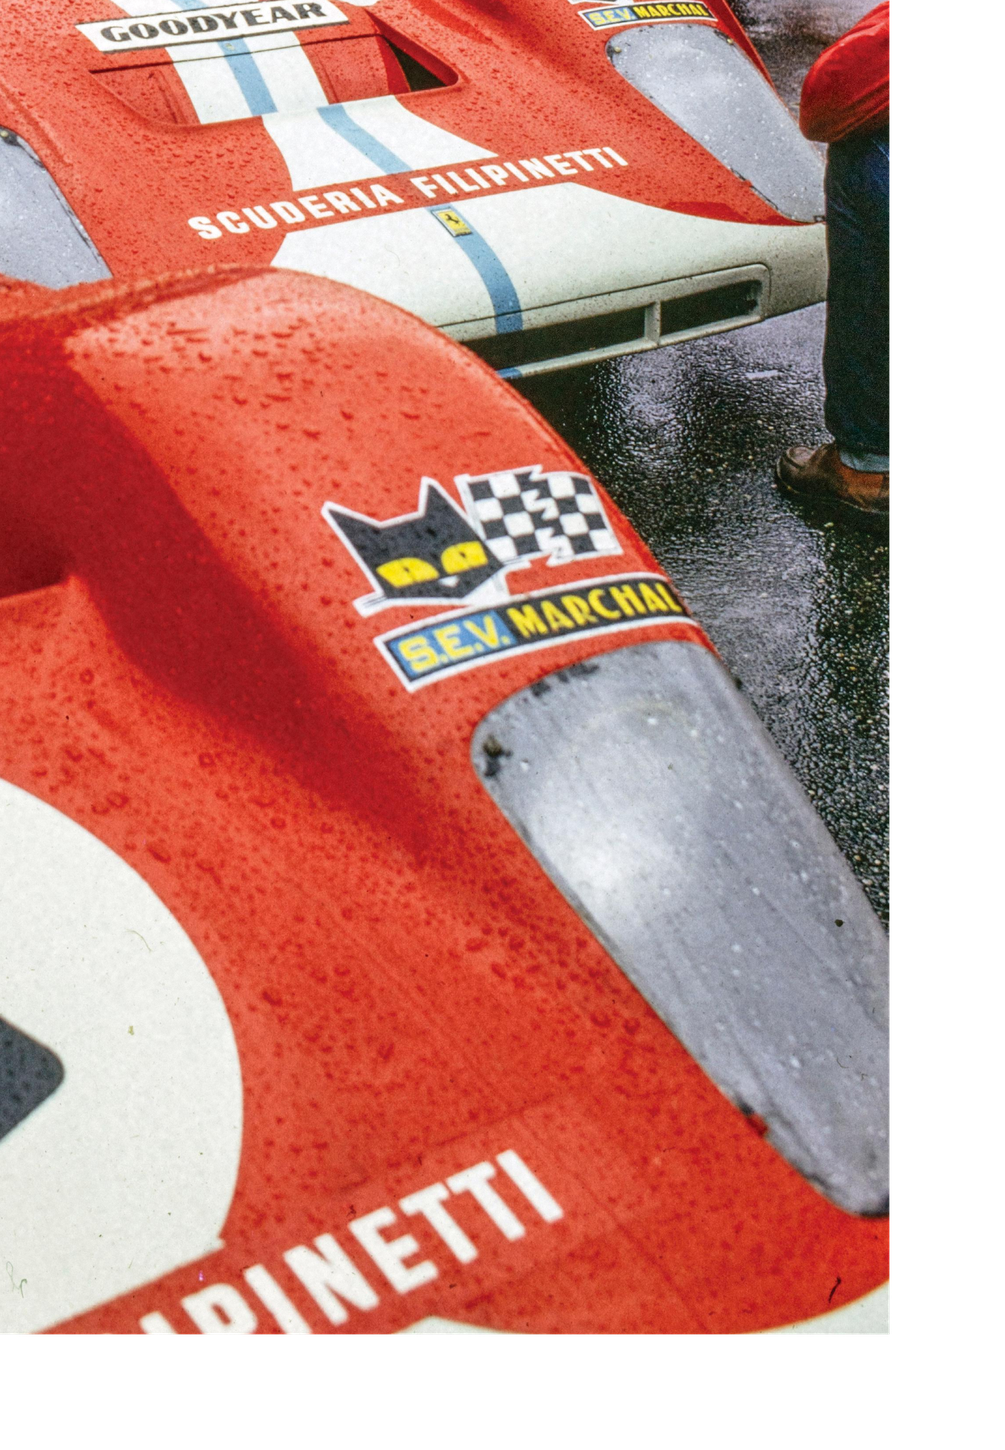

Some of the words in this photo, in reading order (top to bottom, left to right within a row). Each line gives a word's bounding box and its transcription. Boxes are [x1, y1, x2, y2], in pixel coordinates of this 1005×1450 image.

[100, 3, 327, 42] GOODYEAR
[588, 6, 635, 26] S.E.V.
[632, 2, 709, 19] MARCHAL
[188, 182, 405, 240] SCUDERIA
[410, 146, 629, 200] FILIPINETTI
[397, 617, 512, 674] S.E.V.
[506, 581, 682, 638] MARCHAL
